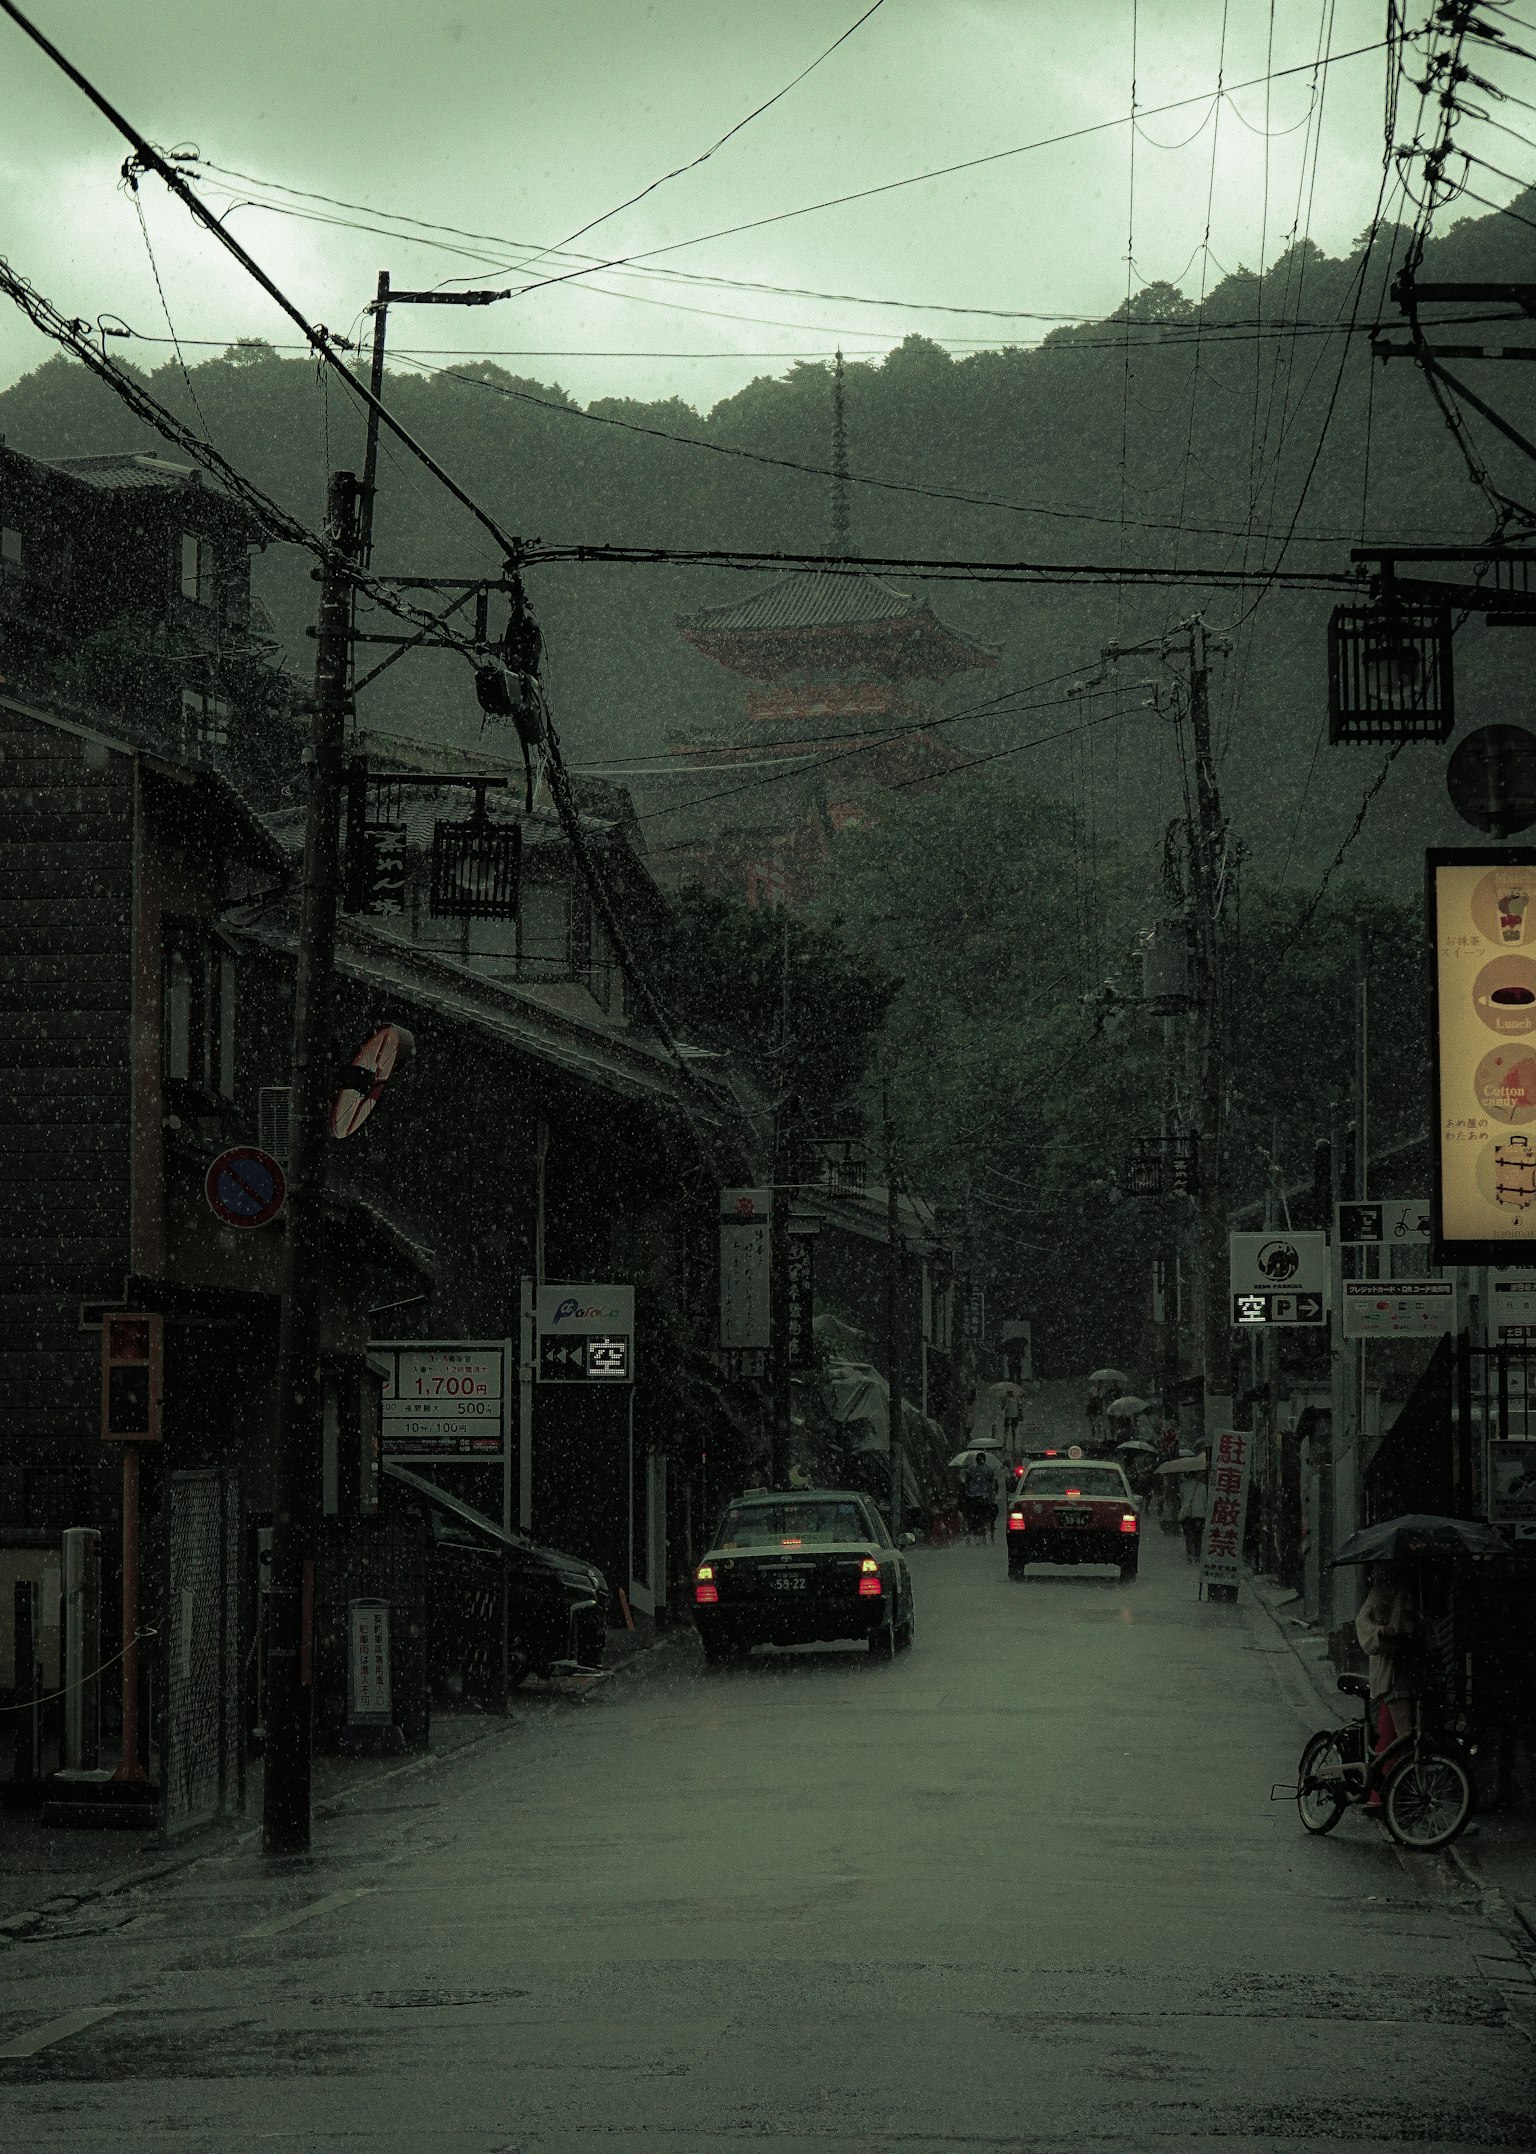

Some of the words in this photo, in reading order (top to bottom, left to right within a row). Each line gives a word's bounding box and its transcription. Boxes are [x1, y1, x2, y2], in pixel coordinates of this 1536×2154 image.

[370, 828, 407, 917] 茶わん坂
[1496, 1018, 1532, 1029] Lunch
[1484, 1085, 1525, 1096] Cotton
[1481, 1096, 1518, 1108] candy
[1445, 1131, 1488, 1141] わたあめ
[1238, 1295, 1266, 1322] 空
[1277, 1299, 1291, 1316] P
[589, 1338, 625, 1375] 空
[1208, 1434, 1246, 1557] 駐車厳禁
